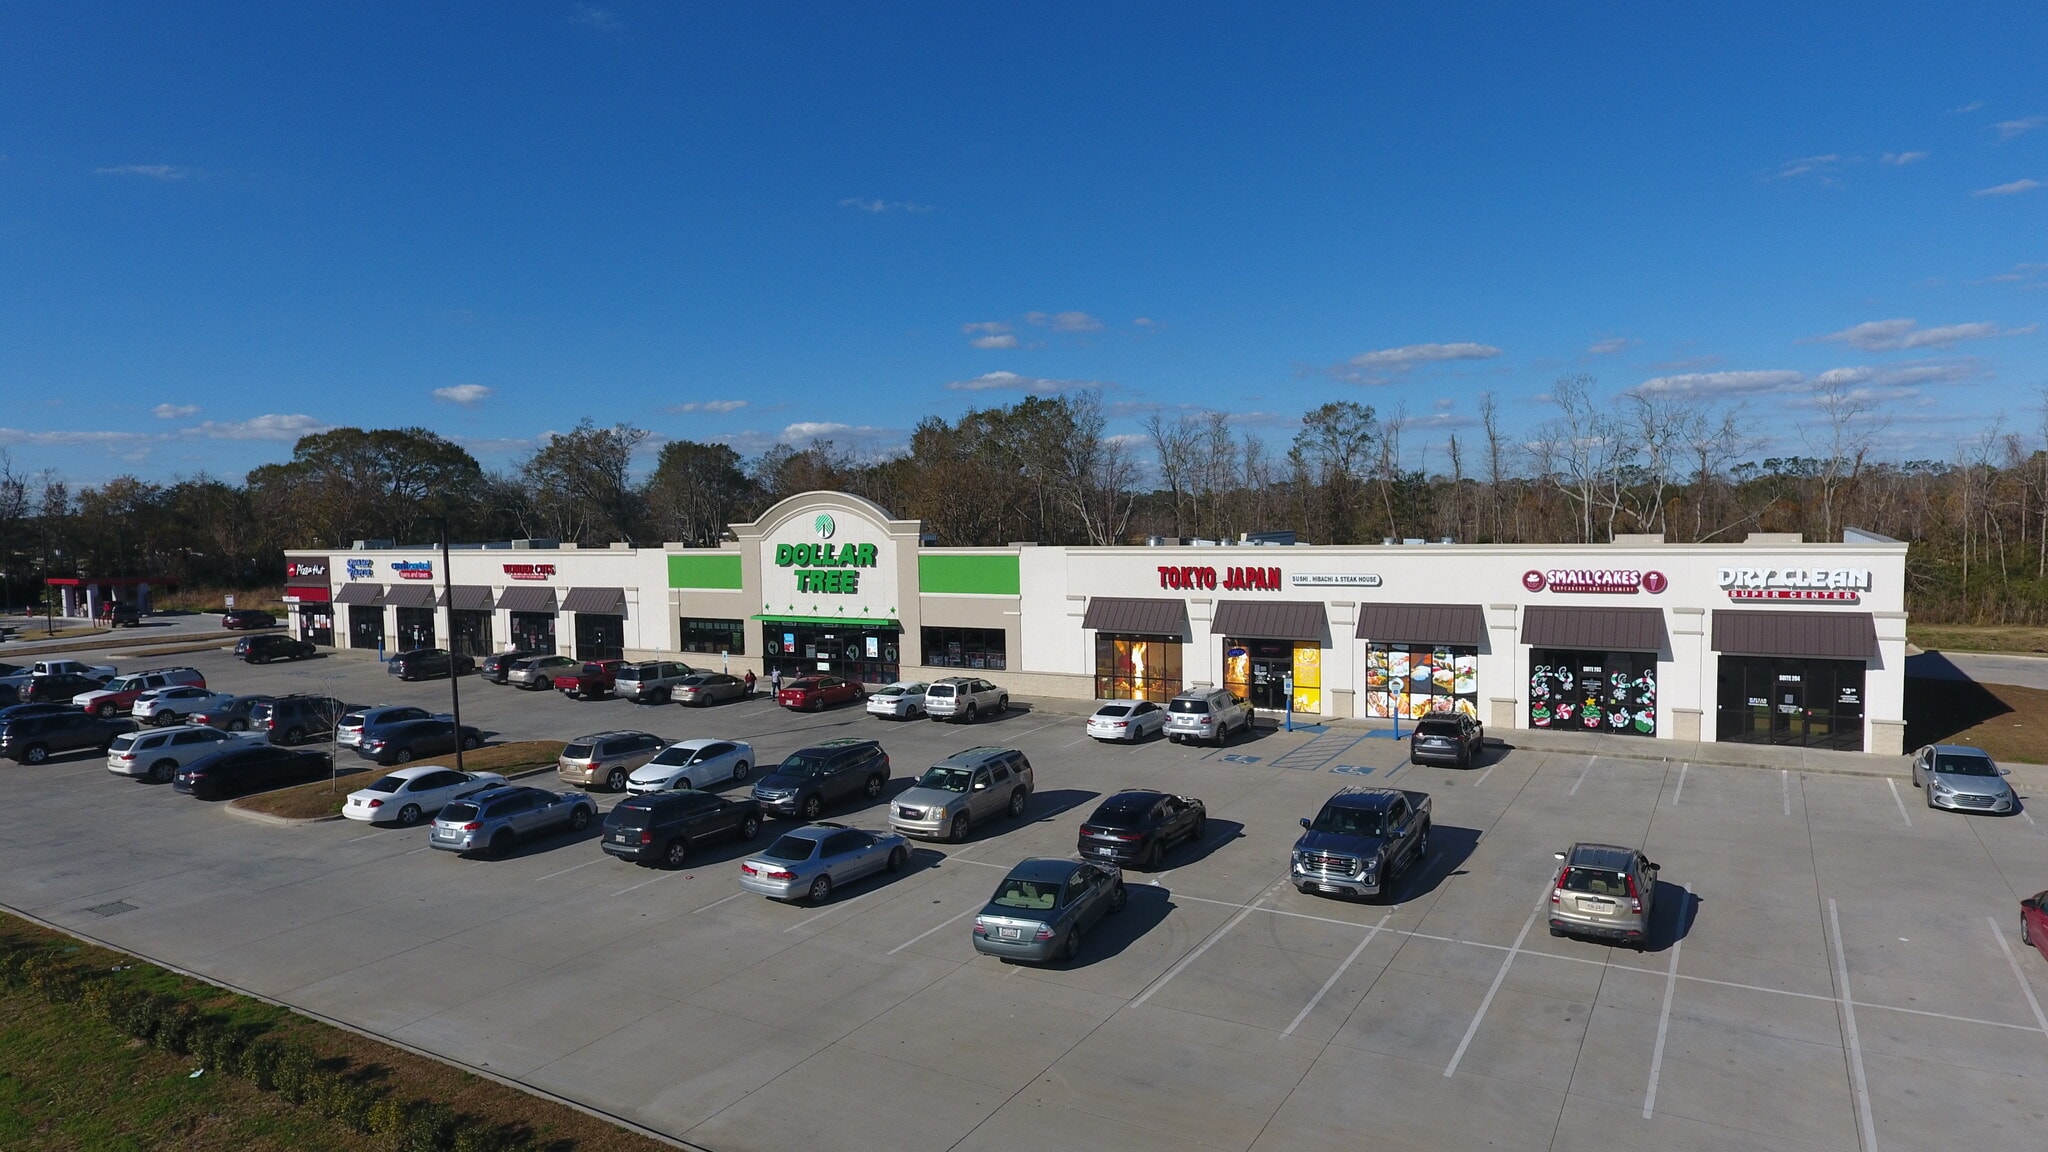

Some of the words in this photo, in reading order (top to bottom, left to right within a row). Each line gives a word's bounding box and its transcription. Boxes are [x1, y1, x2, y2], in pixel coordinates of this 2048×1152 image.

[775, 543, 877, 567] DOLLAR
[296, 564, 312, 576] Pizza
[312, 564, 326, 575] Hut
[1157, 566, 1217, 590] TOKYO
[1223, 566, 1282, 591] JAPAN
[1717, 567, 1774, 589] DRY
[1780, 567, 1871, 590] CLEAN
[794, 570, 859, 594] TREE
[1730, 590, 1780, 598] SUPER
[1789, 591, 1853, 599] CENTER
